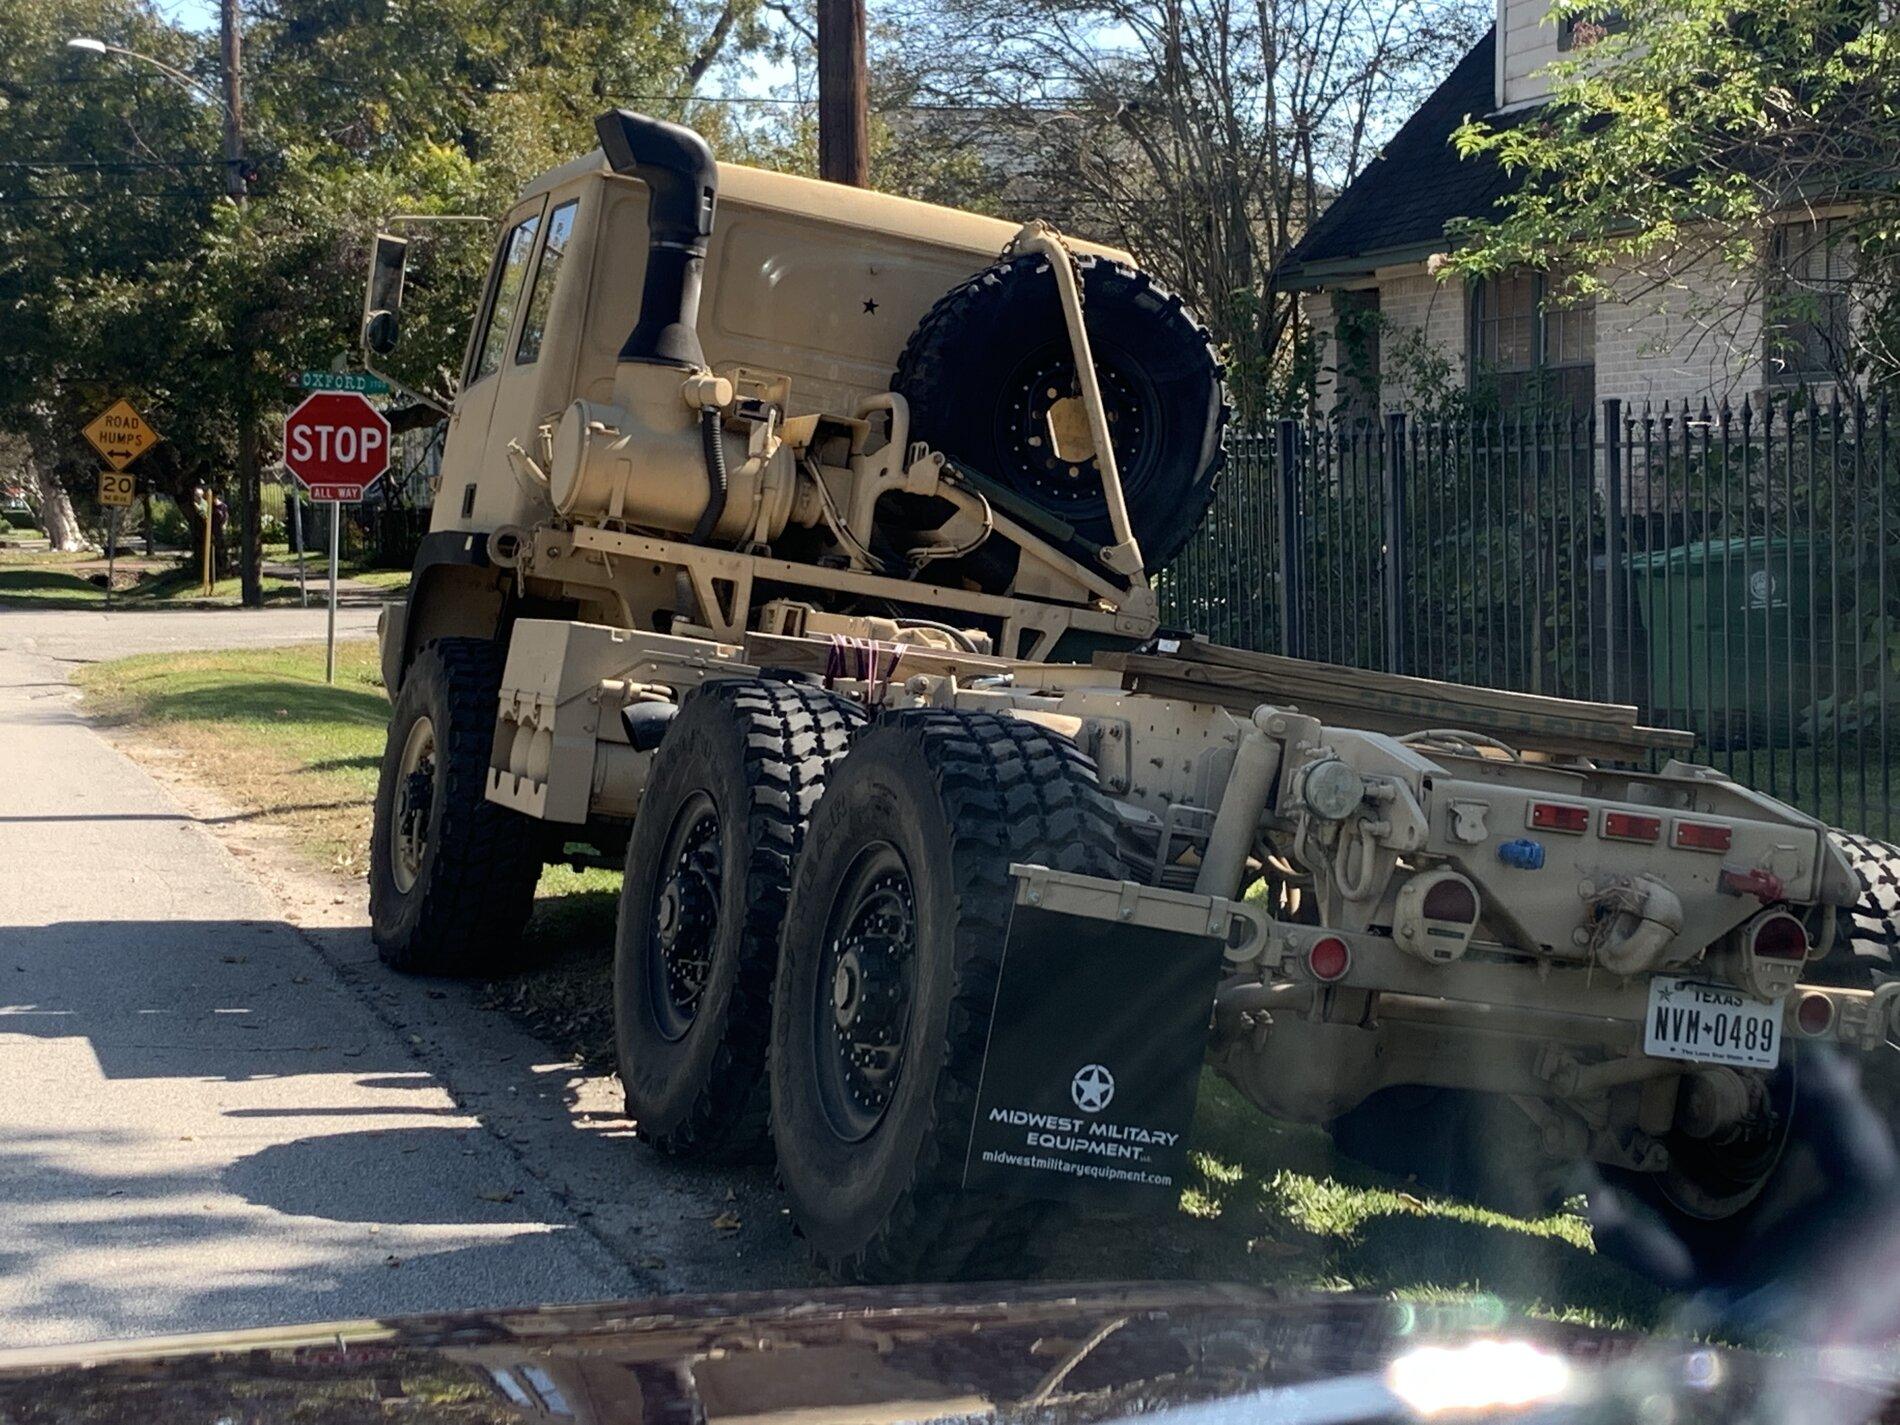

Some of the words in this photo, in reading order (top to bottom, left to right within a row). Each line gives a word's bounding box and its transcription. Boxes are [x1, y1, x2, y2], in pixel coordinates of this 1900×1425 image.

[303, 373, 366, 390] OXFORD
[105, 415, 139, 430] ROAD
[100, 431, 143, 446] HUMPS
[291, 424, 382, 463] STOP
[103, 476, 131, 493] 20
[314, 487, 332, 498] ALL
[338, 488, 358, 498] WAY
[1694, 990, 1743, 1007] TEXAS
[989, 1107, 1084, 1133] MIDWEST
[1089, 1121, 1179, 1147] MILITARY
[1027, 1132, 1143, 1161] EQUIPMENT
[982, 1150, 1172, 1186] midwestmilitaryequipment.com
